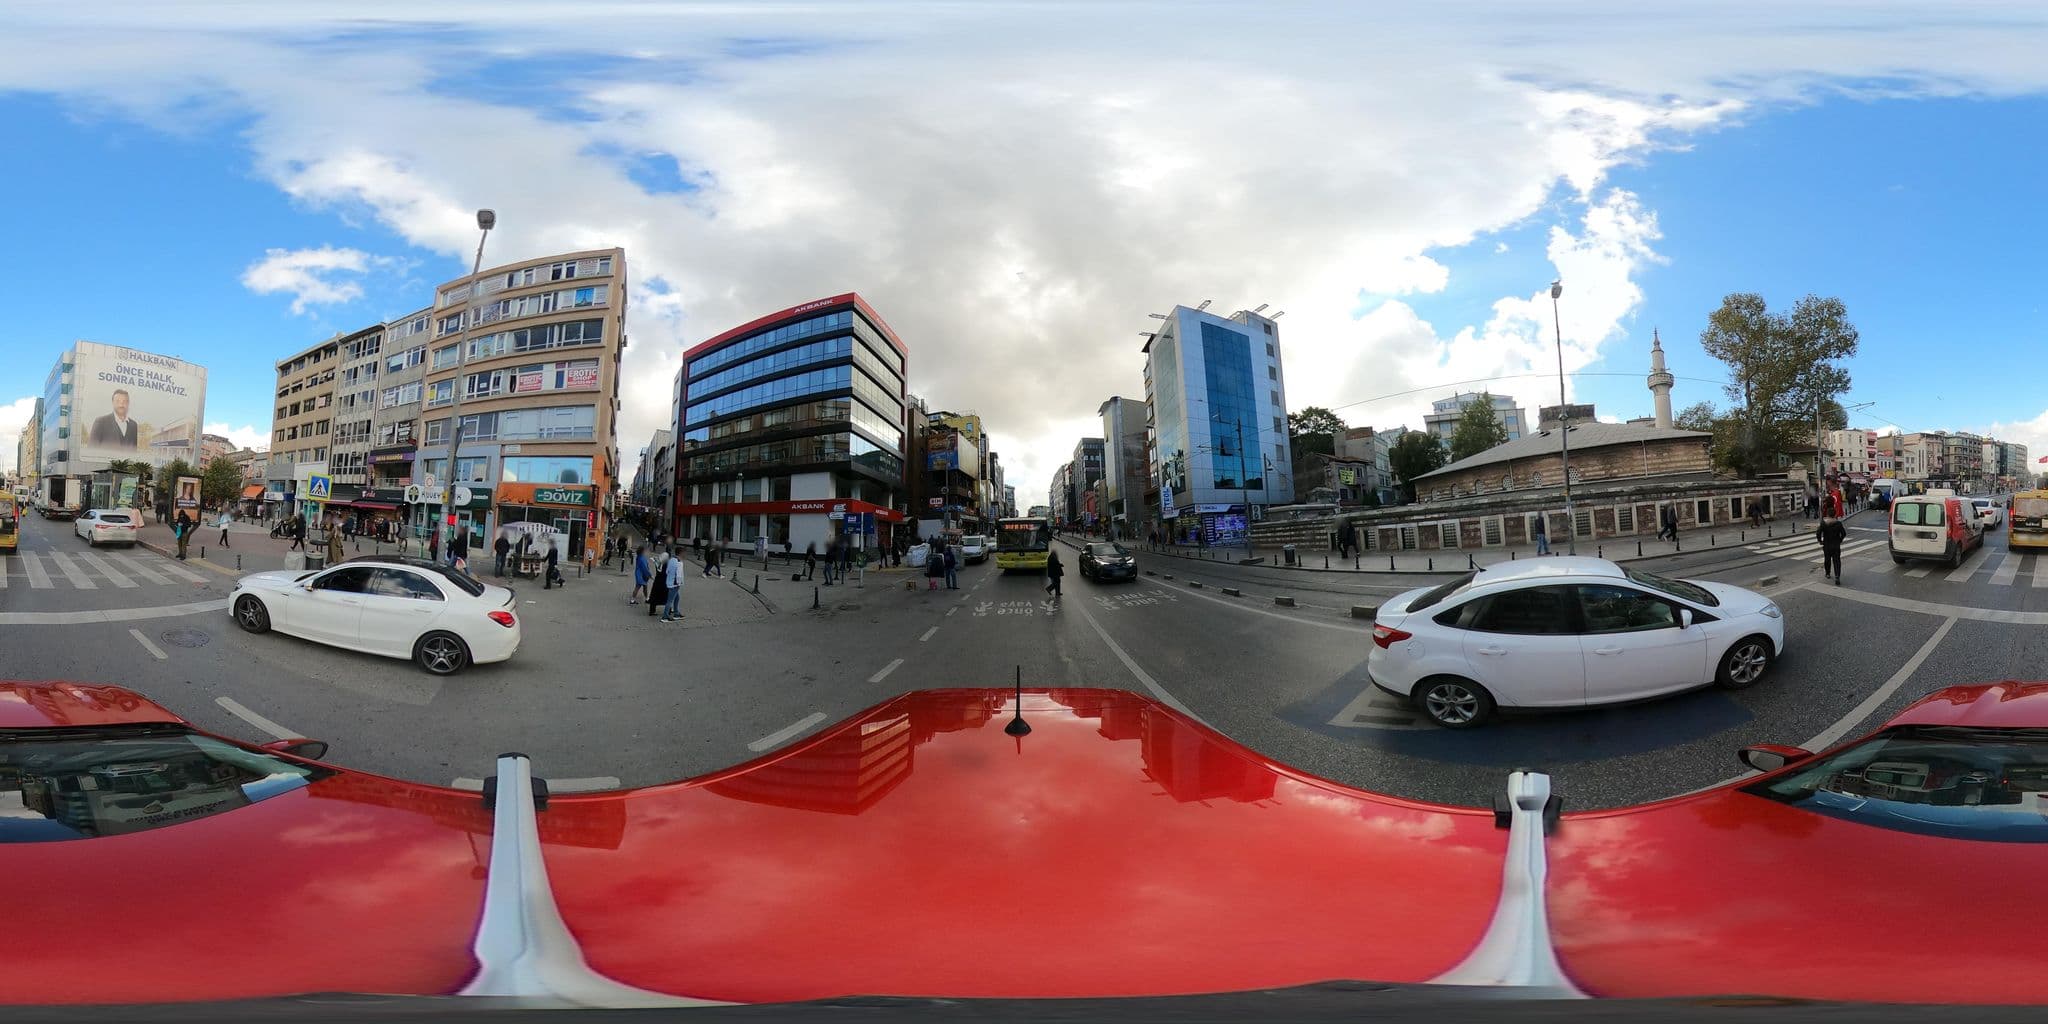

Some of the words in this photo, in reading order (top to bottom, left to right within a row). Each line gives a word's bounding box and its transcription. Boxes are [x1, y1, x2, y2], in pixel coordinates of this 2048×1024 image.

[794, 300, 834, 313] AKBANK
[129, 352, 177, 369] HALKBANK
[115, 362, 144, 377] ÖNCE
[569, 368, 597, 378] EROTIC
[98, 372, 135, 386] SONRA
